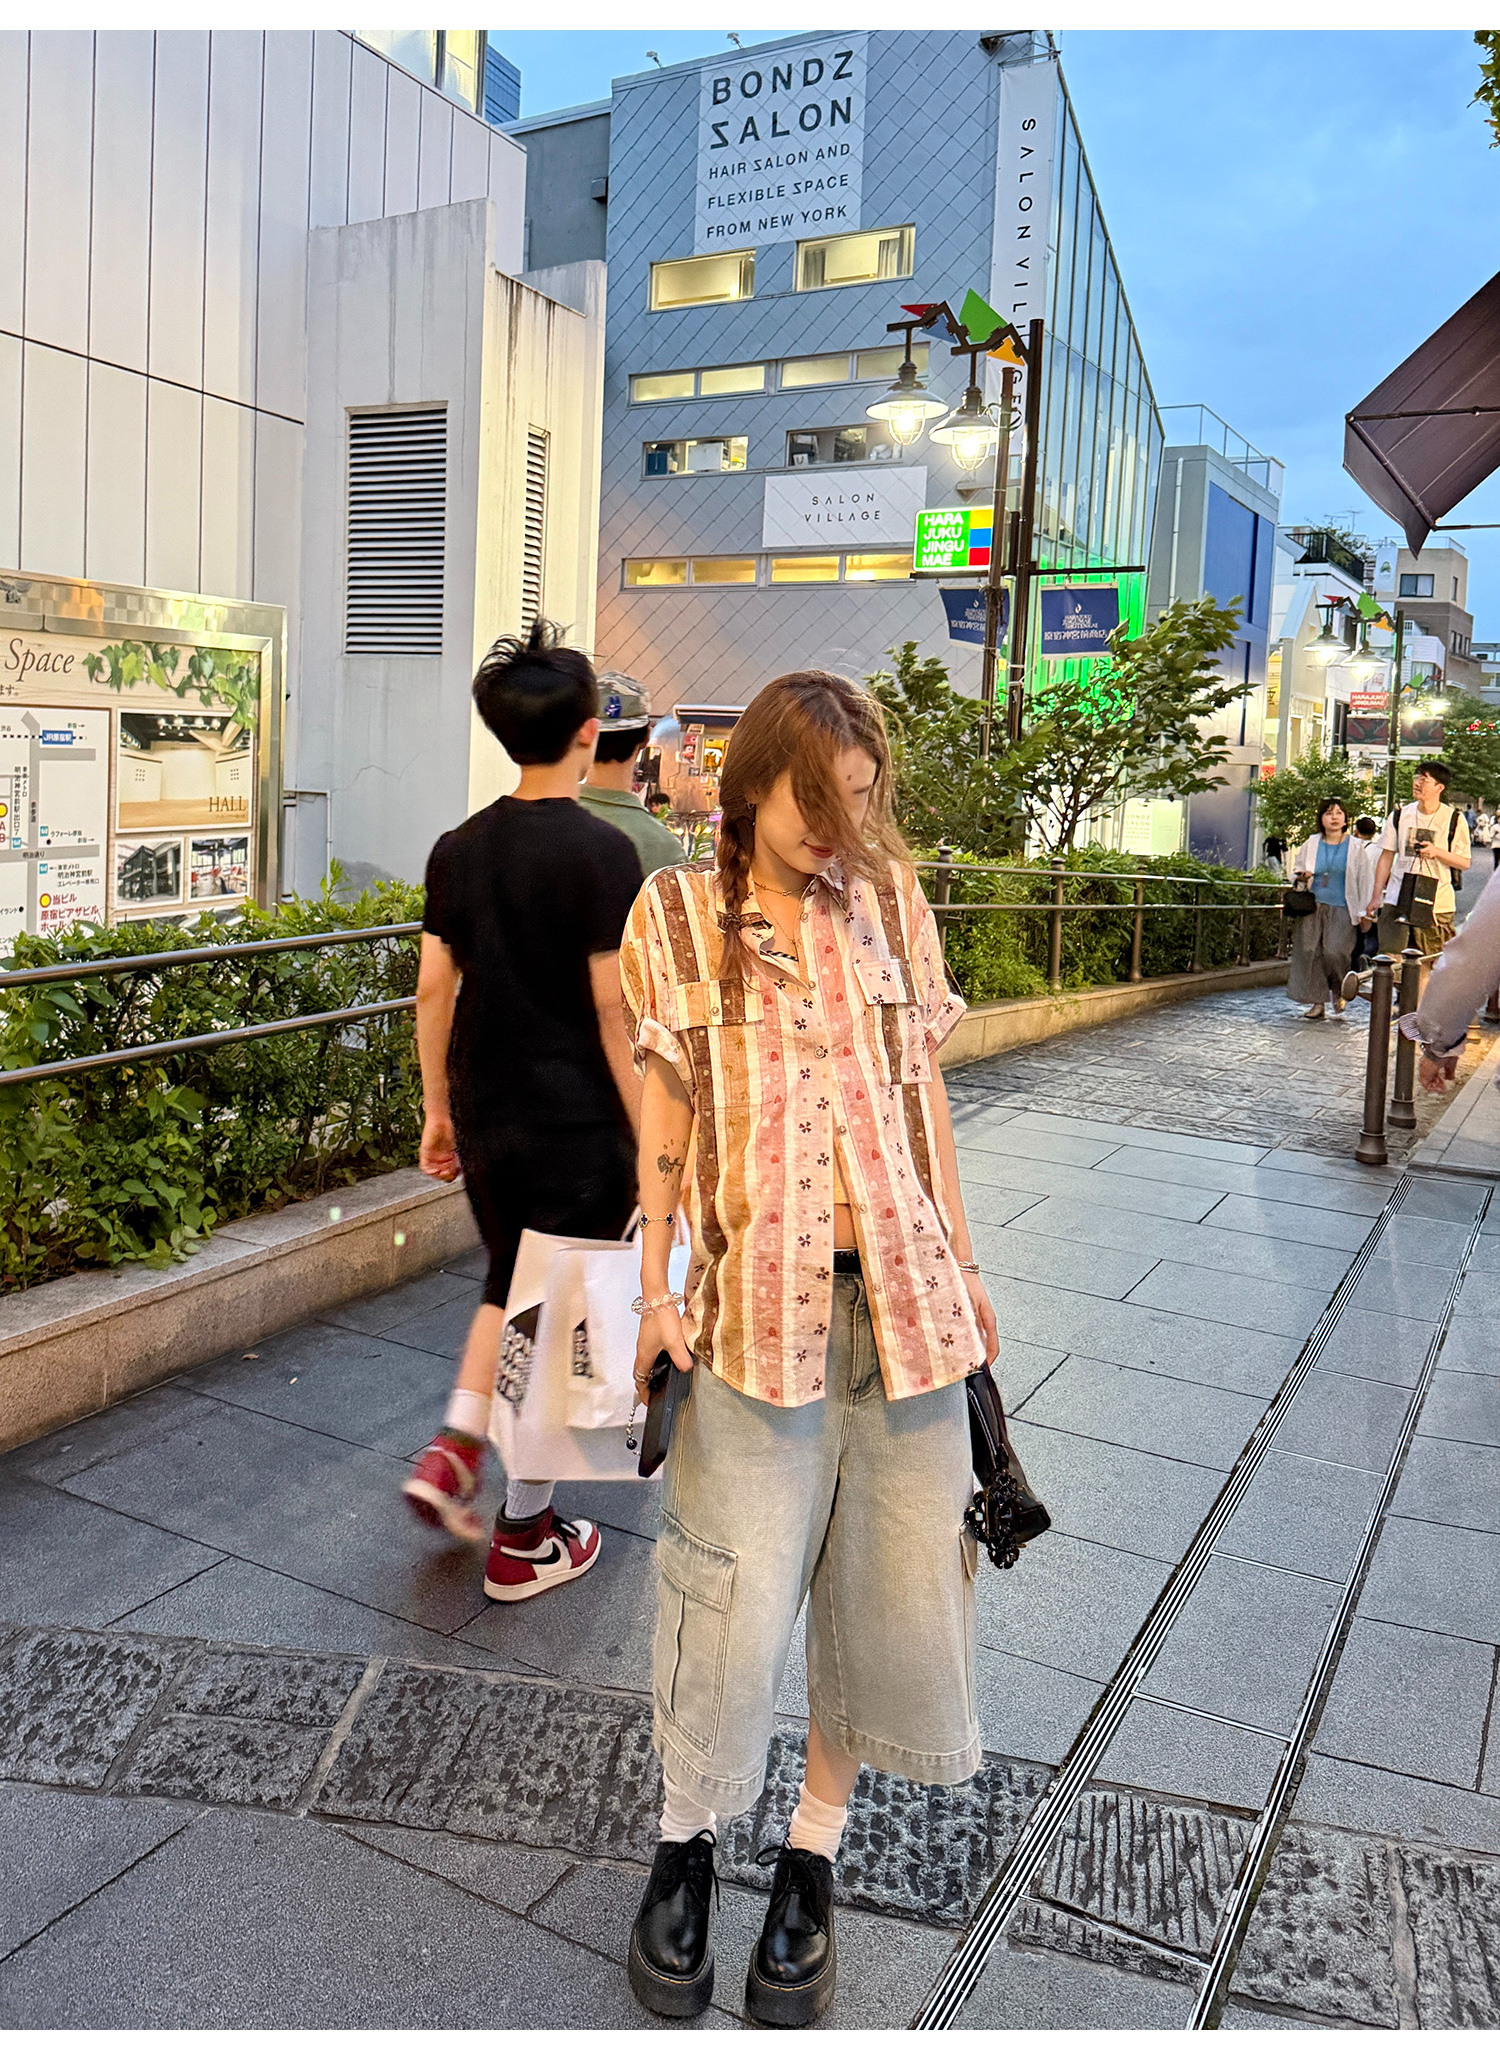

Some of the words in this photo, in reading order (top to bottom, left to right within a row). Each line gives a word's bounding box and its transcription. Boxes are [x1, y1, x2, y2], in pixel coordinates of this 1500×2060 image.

[713, 50, 853, 105] BONDZ
[709, 162, 746, 179] HAIR
[816, 143, 850, 160] AND
[1017, 118, 1036, 240] SALON
[708, 185, 785, 209] FLEXIBLE
[707, 220, 751, 238] FROM
[758, 213, 794, 231] NEW
[801, 205, 847, 223] YORK
[812, 493, 875, 505] SALON
[805, 510, 880, 522] VILLAGE
[924, 512, 964, 526] HARA
[923, 526, 962, 540] JUKU
[922, 539, 965, 553] JINGU
[922, 553, 953, 566] MAE
[4, 637, 75, 682] Space
[208, 796, 247, 812] HALL
[53, 893, 77, 905] 当ビル
